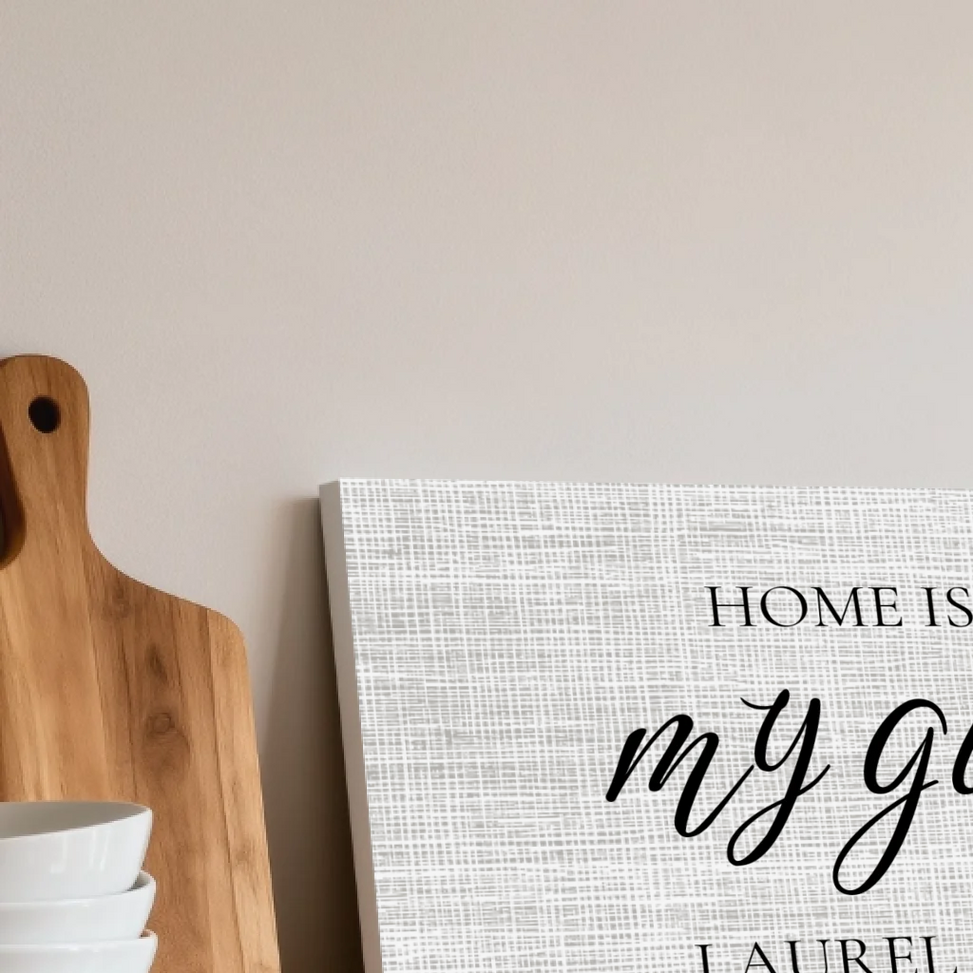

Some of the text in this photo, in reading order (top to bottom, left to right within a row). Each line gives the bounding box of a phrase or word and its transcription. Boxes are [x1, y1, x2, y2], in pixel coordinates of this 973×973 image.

[704, 585, 904, 628] HOME
[920, 586, 973, 629] IS
[604, 687, 832, 867] my
